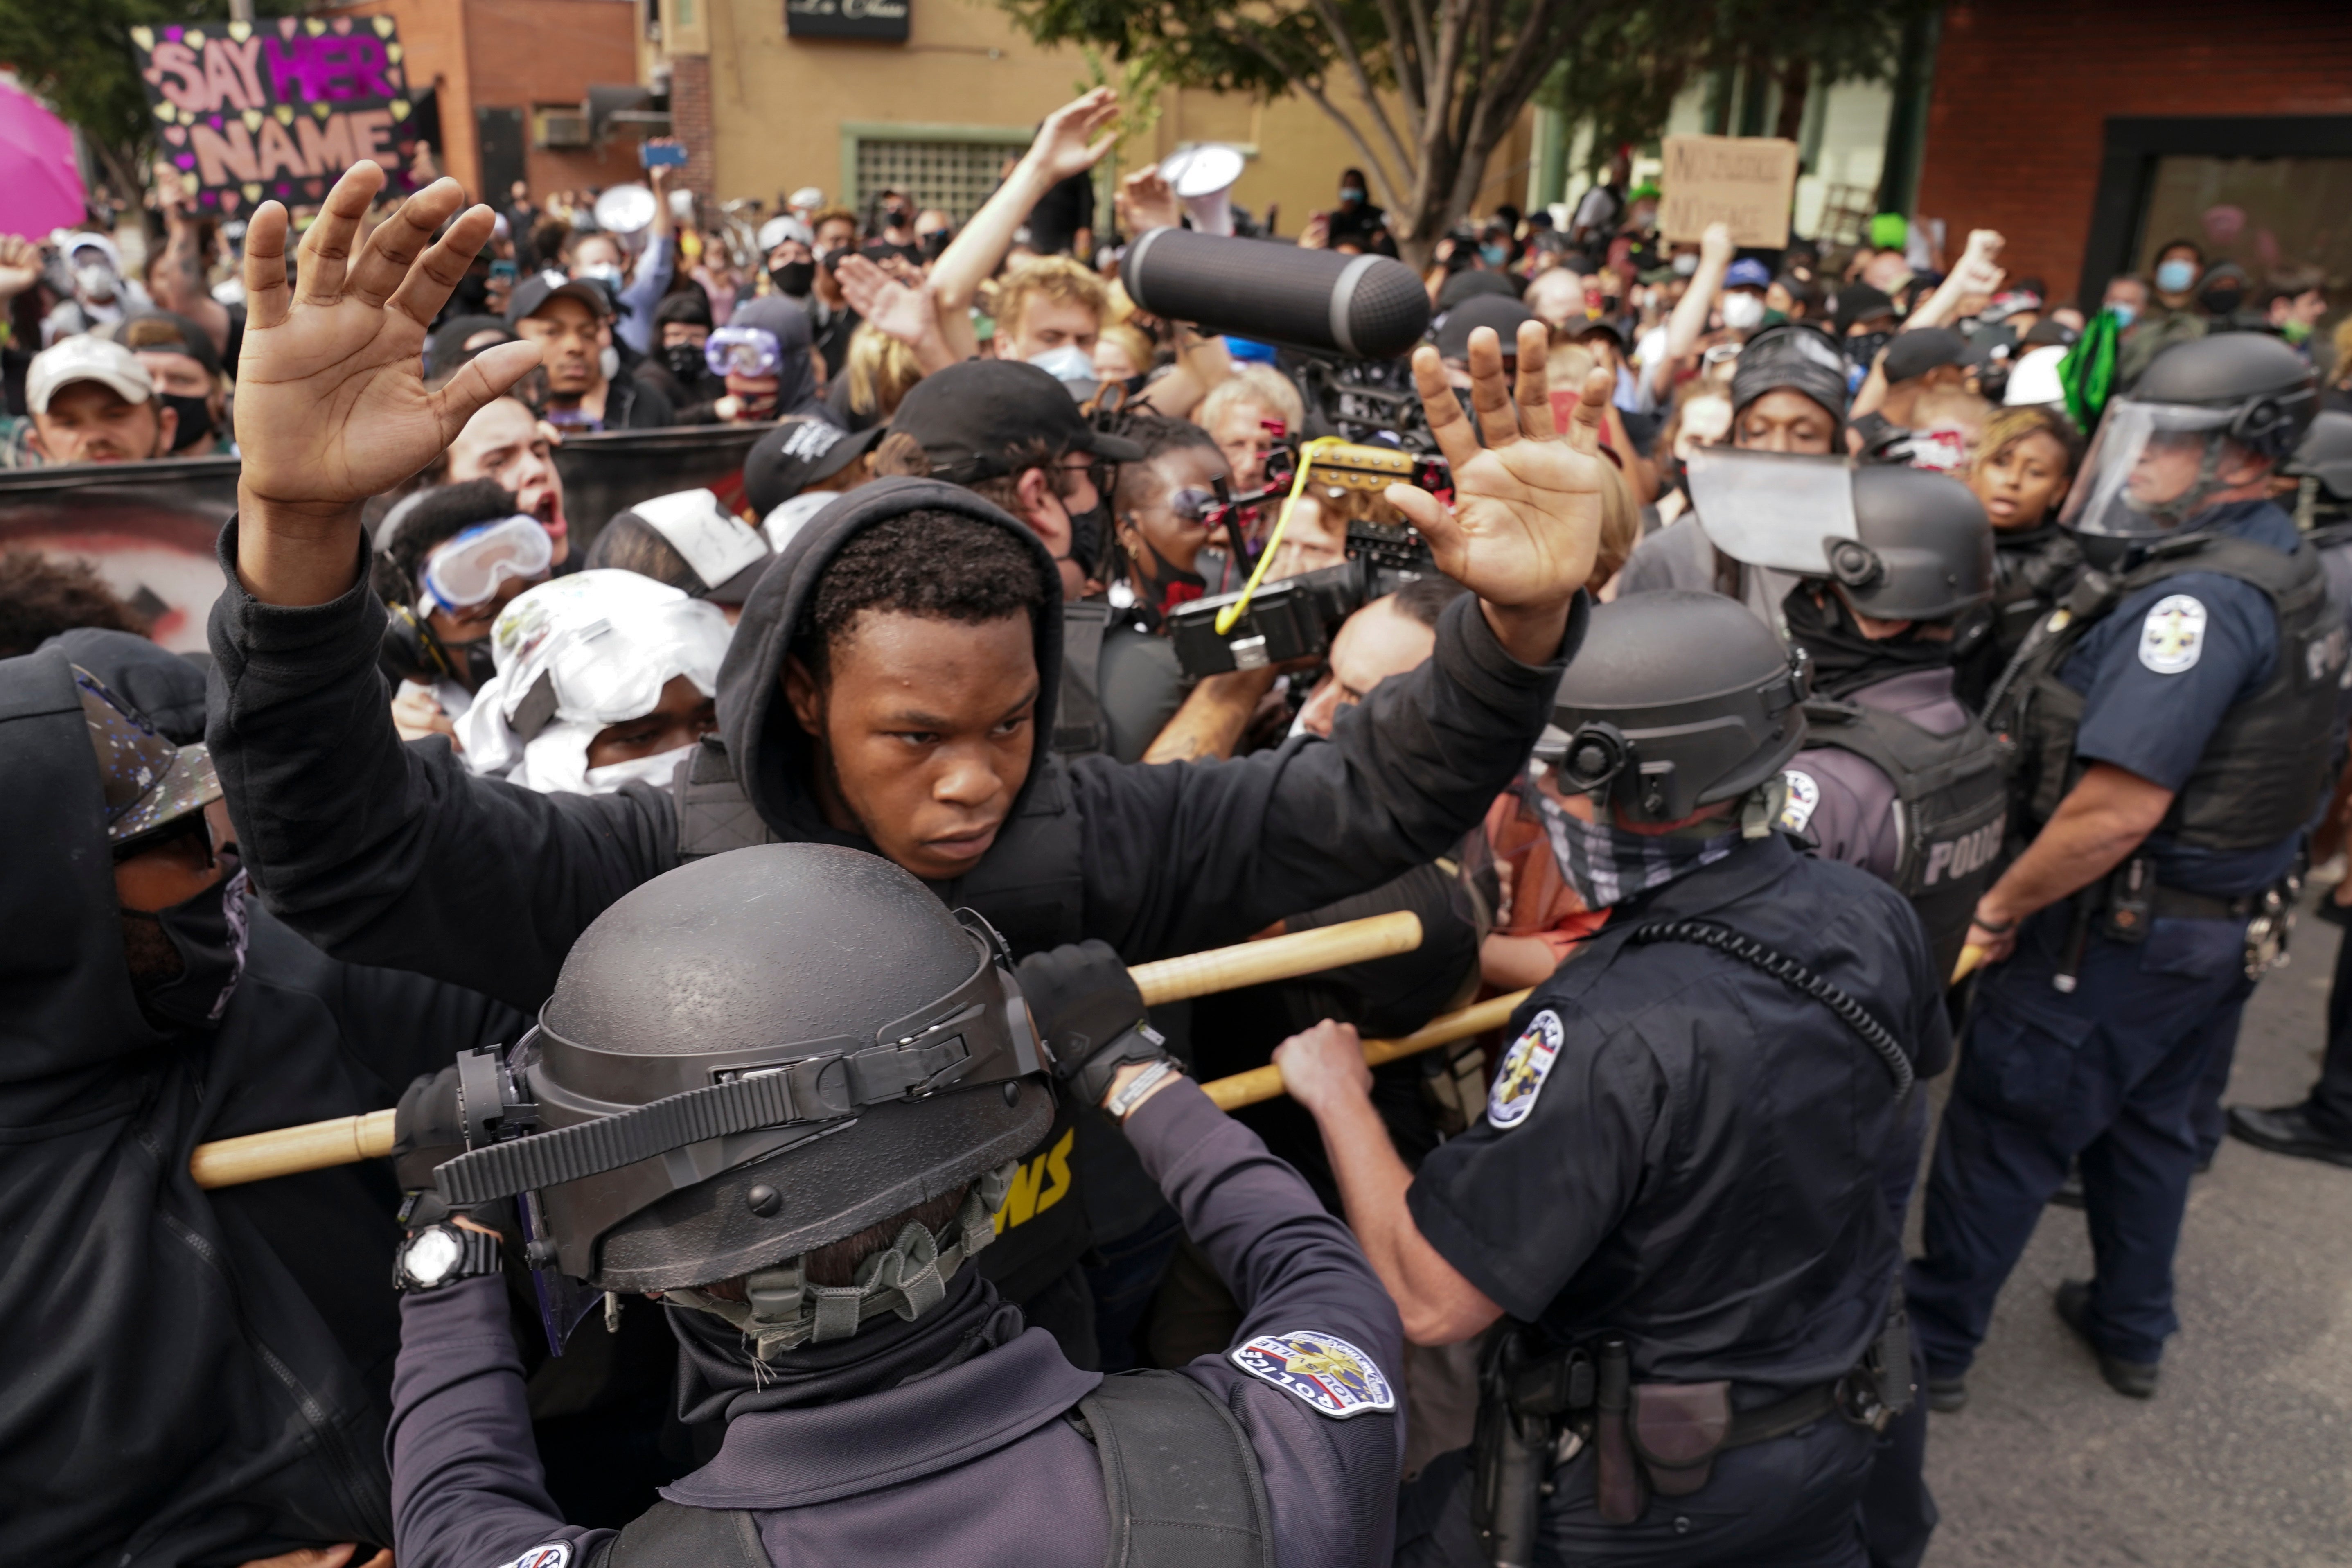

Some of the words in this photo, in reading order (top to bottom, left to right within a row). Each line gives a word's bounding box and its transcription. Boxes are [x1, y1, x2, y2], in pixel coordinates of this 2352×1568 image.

[152, 36, 266, 112] SAY
[264, 34, 396, 102] HER
[188, 108, 399, 186] NAME
[1240, 1351, 1335, 1408] POLICE
[1256, 1340, 1355, 1406] LOUISVILLE
